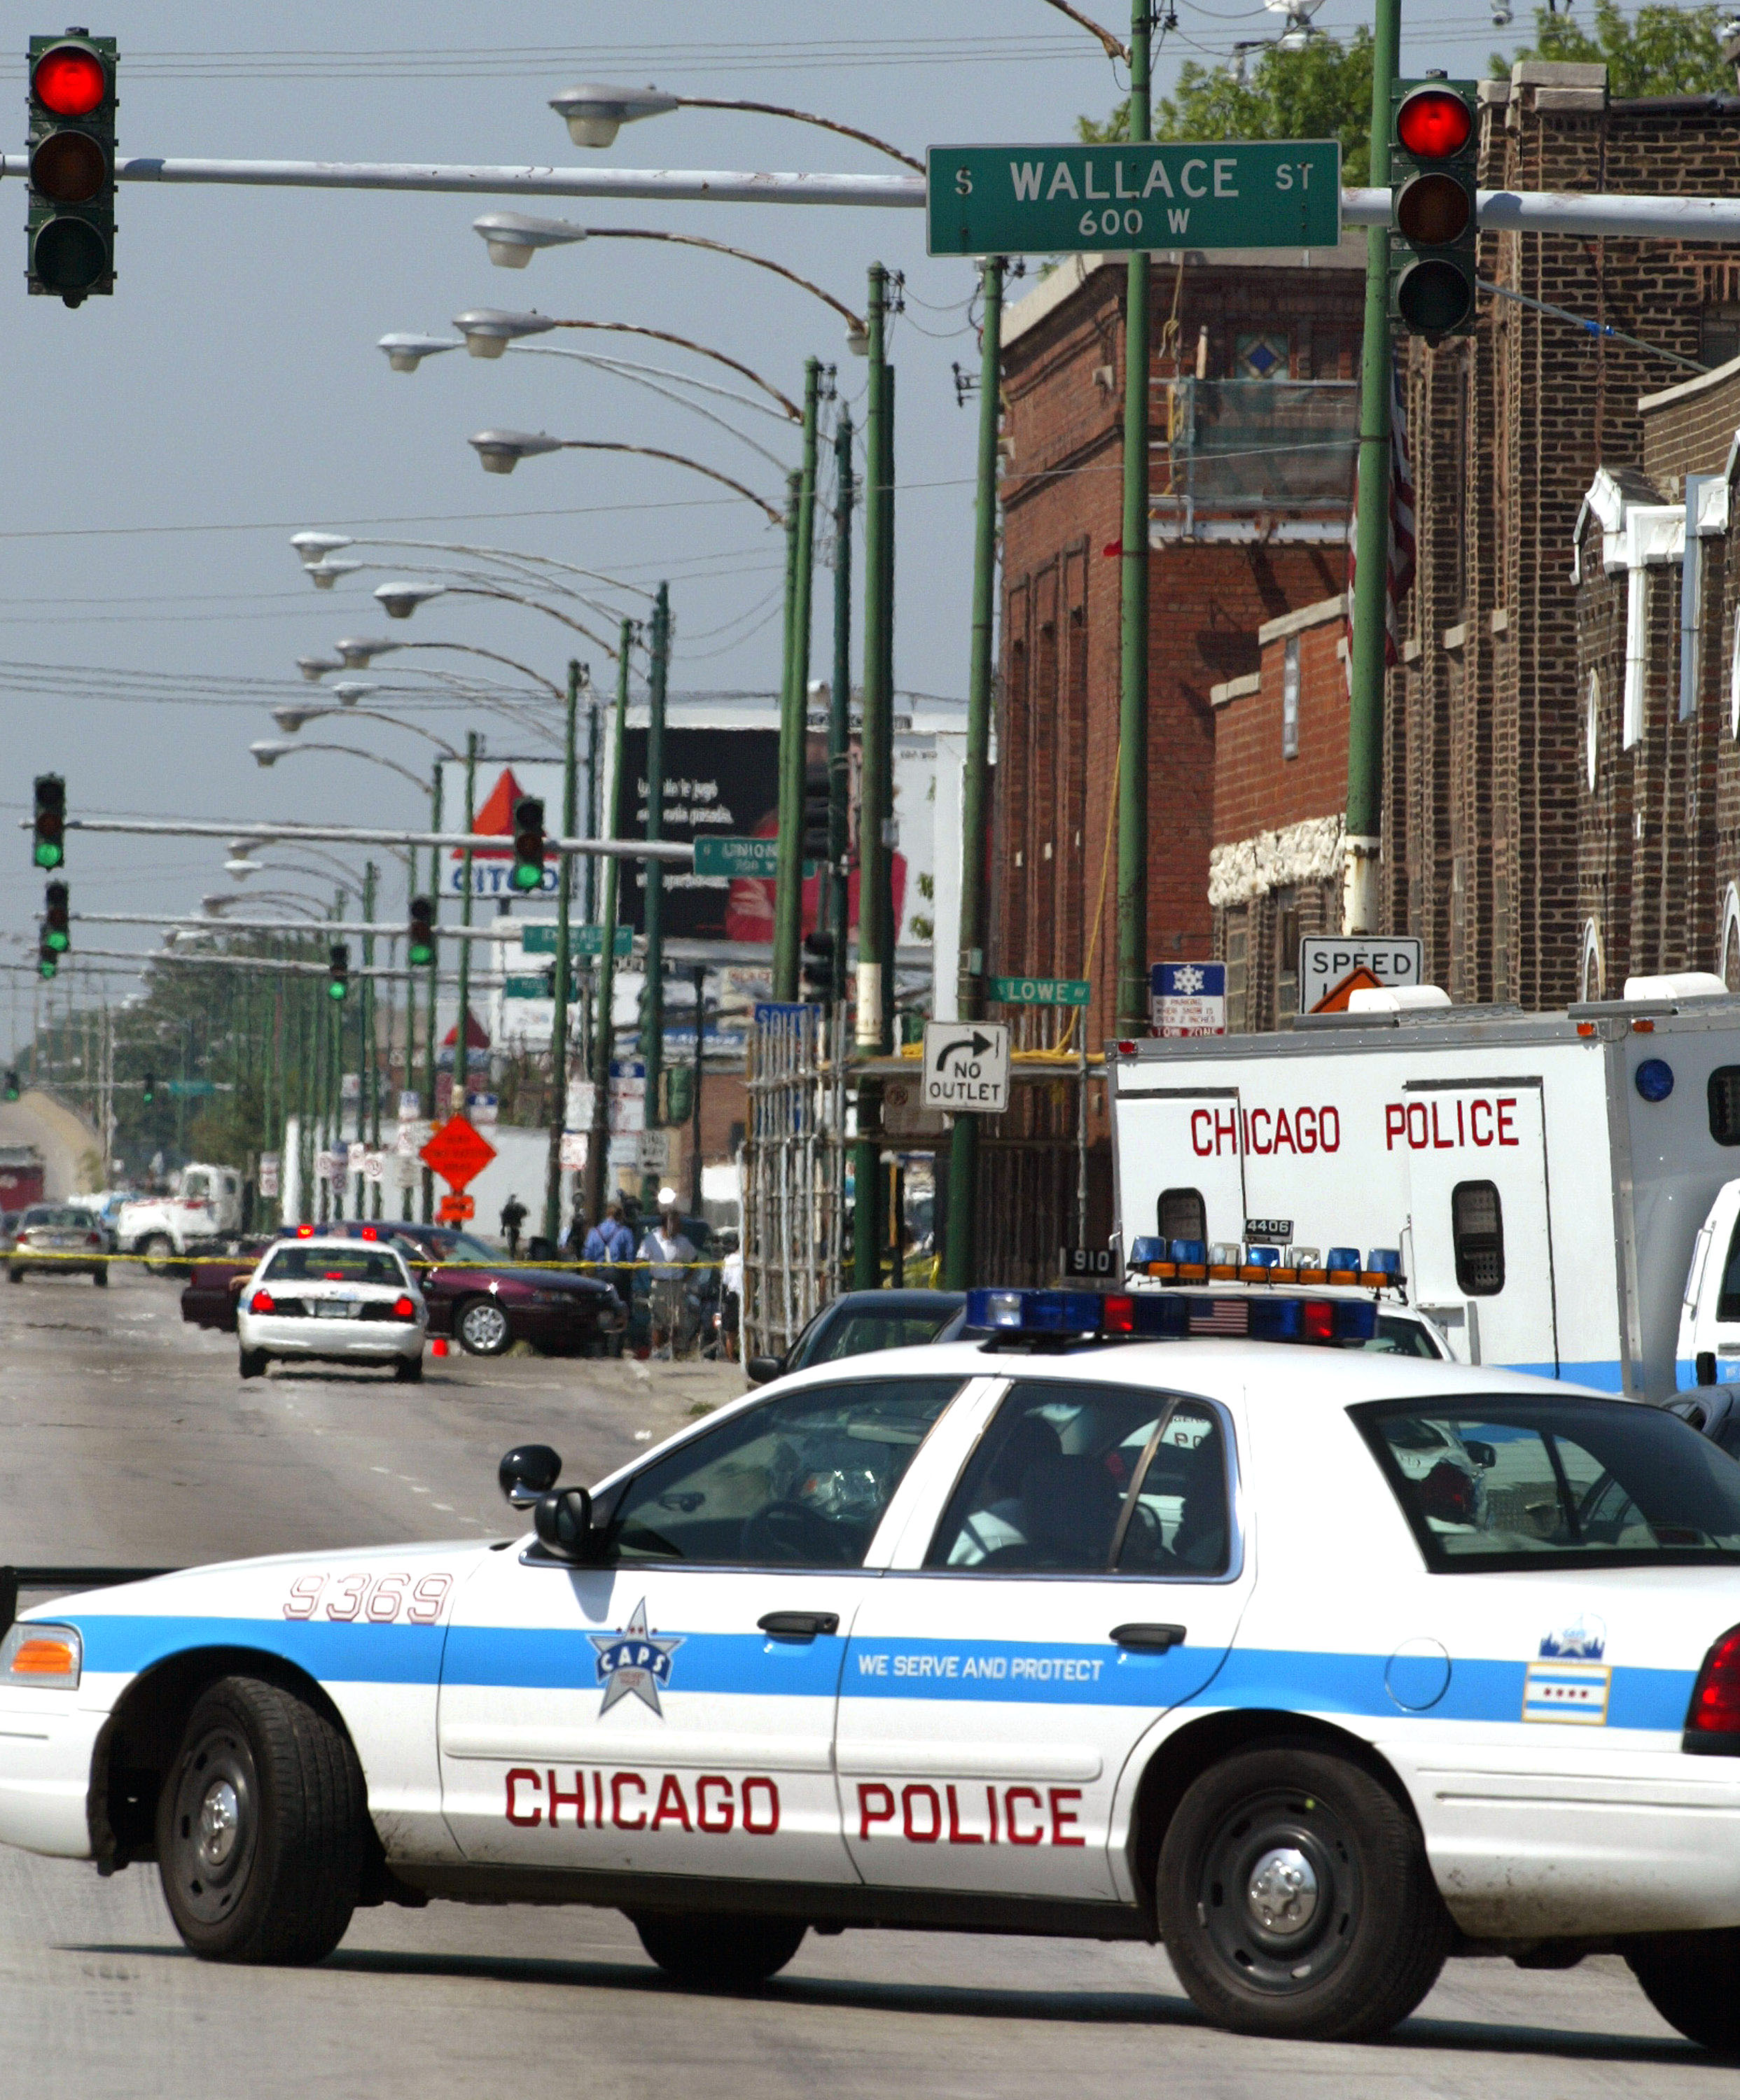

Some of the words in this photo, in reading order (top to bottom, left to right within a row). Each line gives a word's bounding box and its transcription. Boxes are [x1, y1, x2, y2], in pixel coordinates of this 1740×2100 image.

[955, 167, 973, 195] S
[1010, 159, 1239, 201] WALLACE
[1275, 163, 1314, 190] ST
[1078, 209, 1143, 236] 600
[1168, 209, 1190, 234] W
[723, 843, 780, 858] UNION
[452, 867, 559, 893] CITO
[1313, 951, 1412, 974] SPEED
[1007, 981, 1069, 1002] LOWE
[955, 1062, 981, 1079] NO
[930, 1082, 1001, 1100] OUTLET
[1190, 1106, 1340, 1156] CHICAGO
[1385, 1098, 1519, 1150] POLICE
[1247, 1219, 1289, 1233] 4406
[283, 1572, 454, 1625] 9369
[600, 1646, 666, 1672] CAPS
[858, 1654, 890, 1677] WE
[893, 1655, 959, 1679] SERVE
[963, 1657, 1006, 1679] AND
[1010, 1658, 1104, 1681] PROTECT
[506, 1768, 780, 1835] CHICAGO
[857, 1783, 1086, 1847] POLICE
